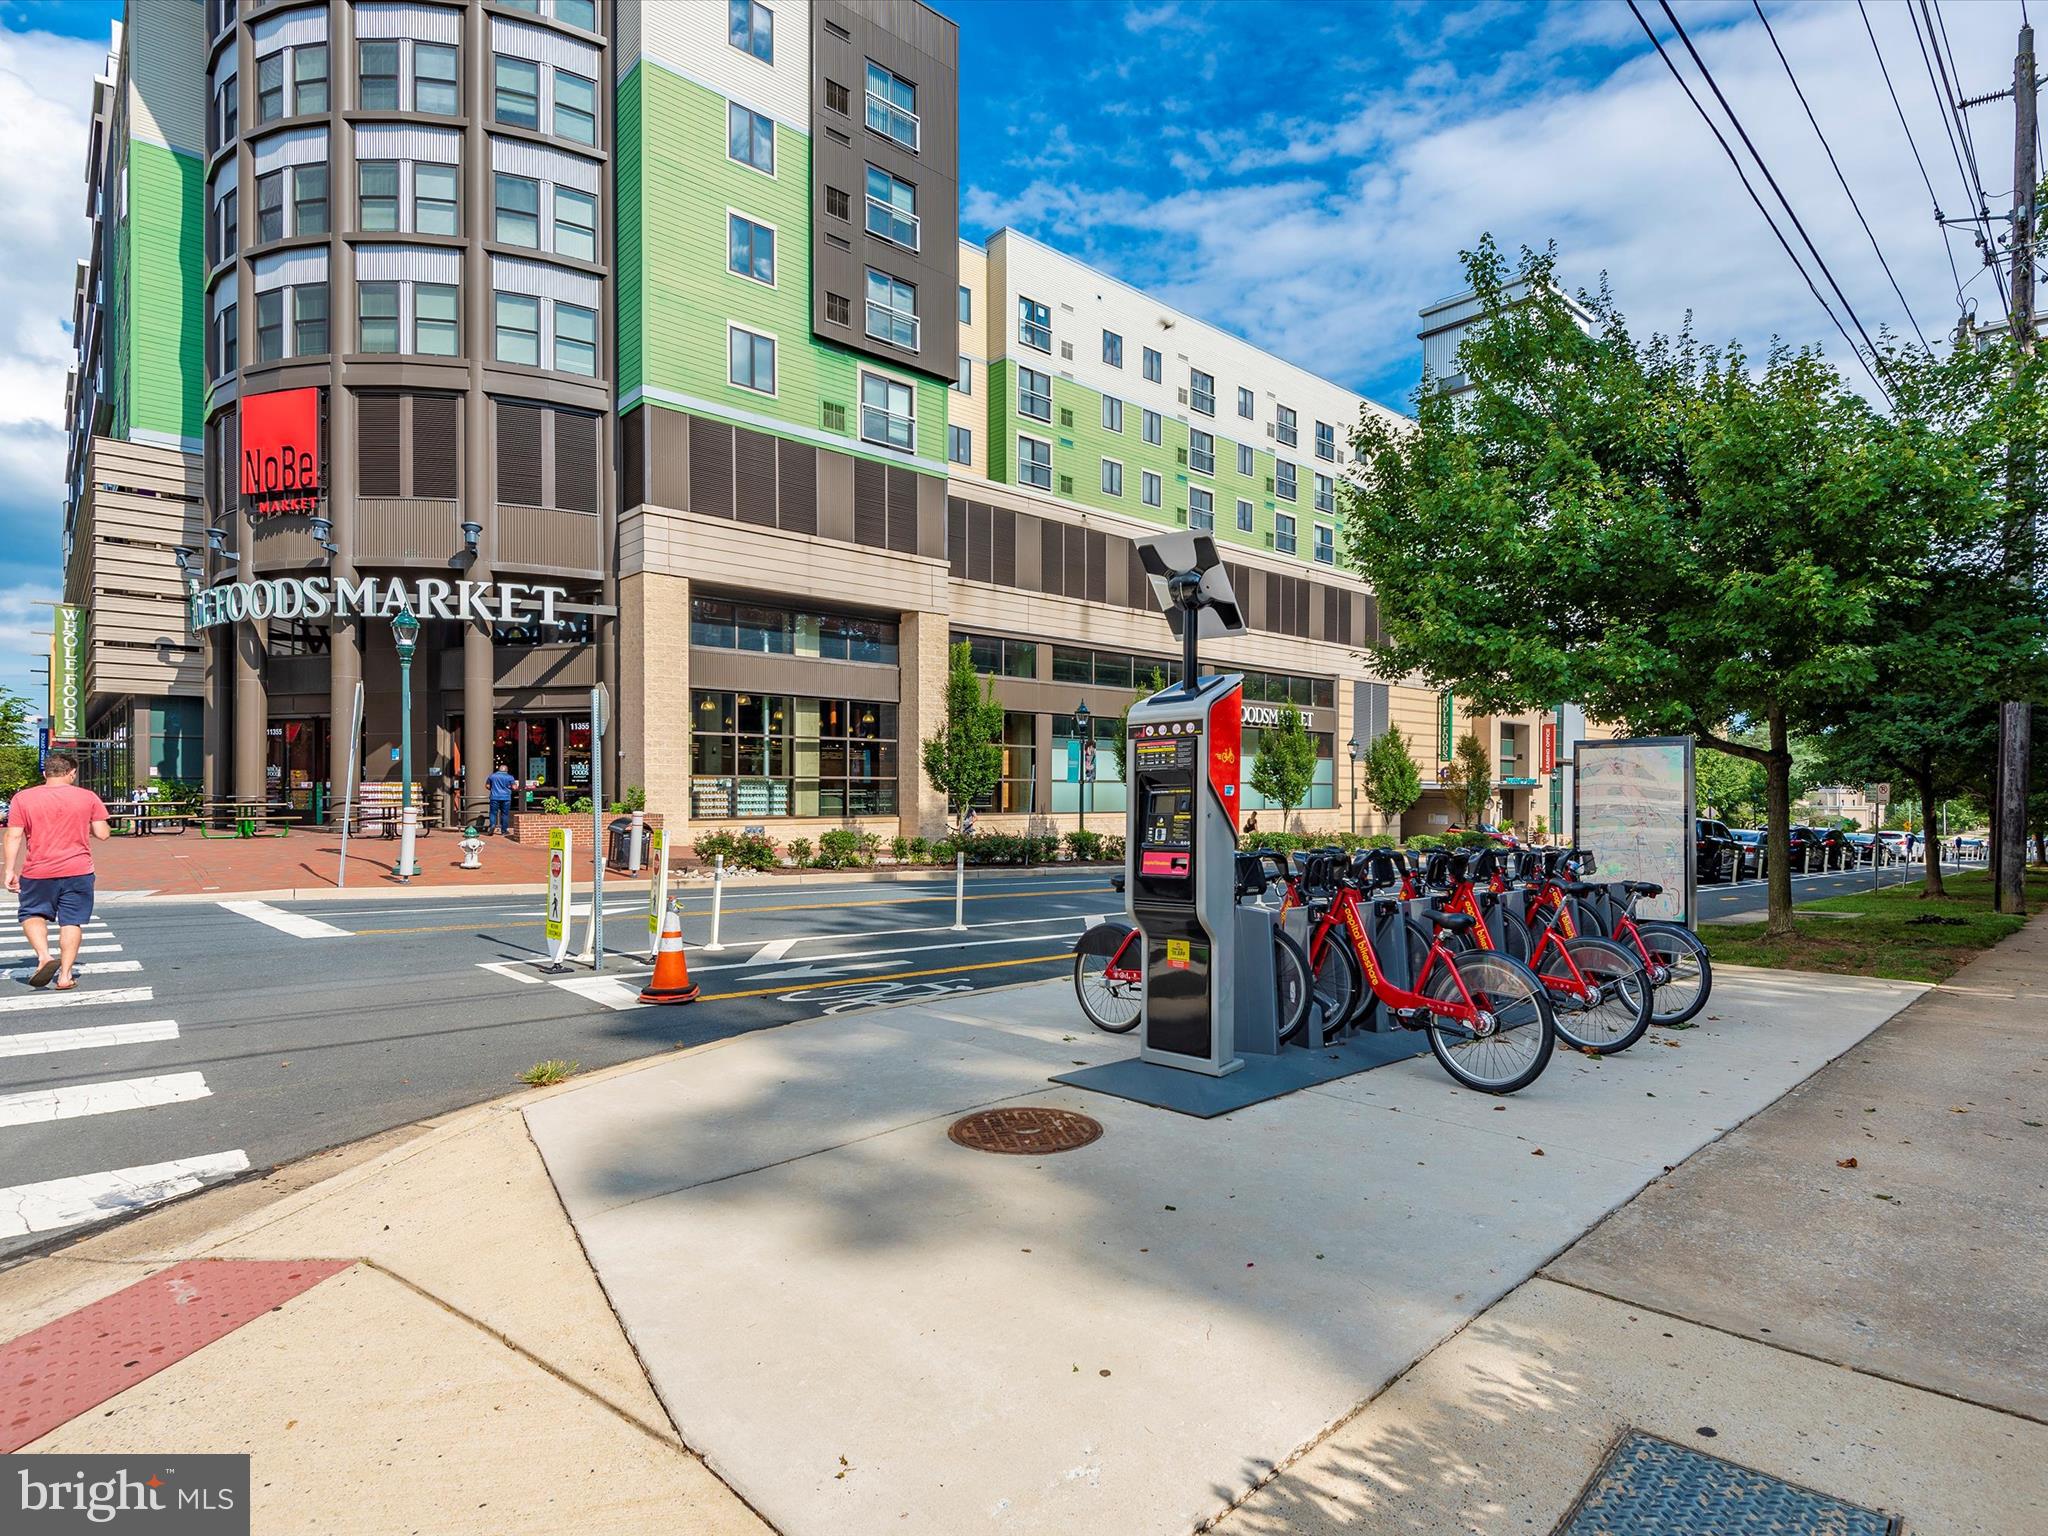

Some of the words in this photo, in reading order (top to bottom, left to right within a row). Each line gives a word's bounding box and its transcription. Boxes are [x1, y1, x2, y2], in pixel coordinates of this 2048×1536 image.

[245, 445, 313, 496] NoBe
[258, 497, 318, 513] MARKET
[214, 576, 330, 624] FOODS
[333, 576, 567, 626] MARKET
[61, 608, 80, 671] WHOLE
[63, 674, 79, 732] FOODS
[570, 722, 590, 730] 11355
[1240, 706, 1270, 724] OODS
[266, 728, 283, 736] 11355
[1344, 908, 1362, 940] capital
[1357, 938, 1379, 986] bikeshare
